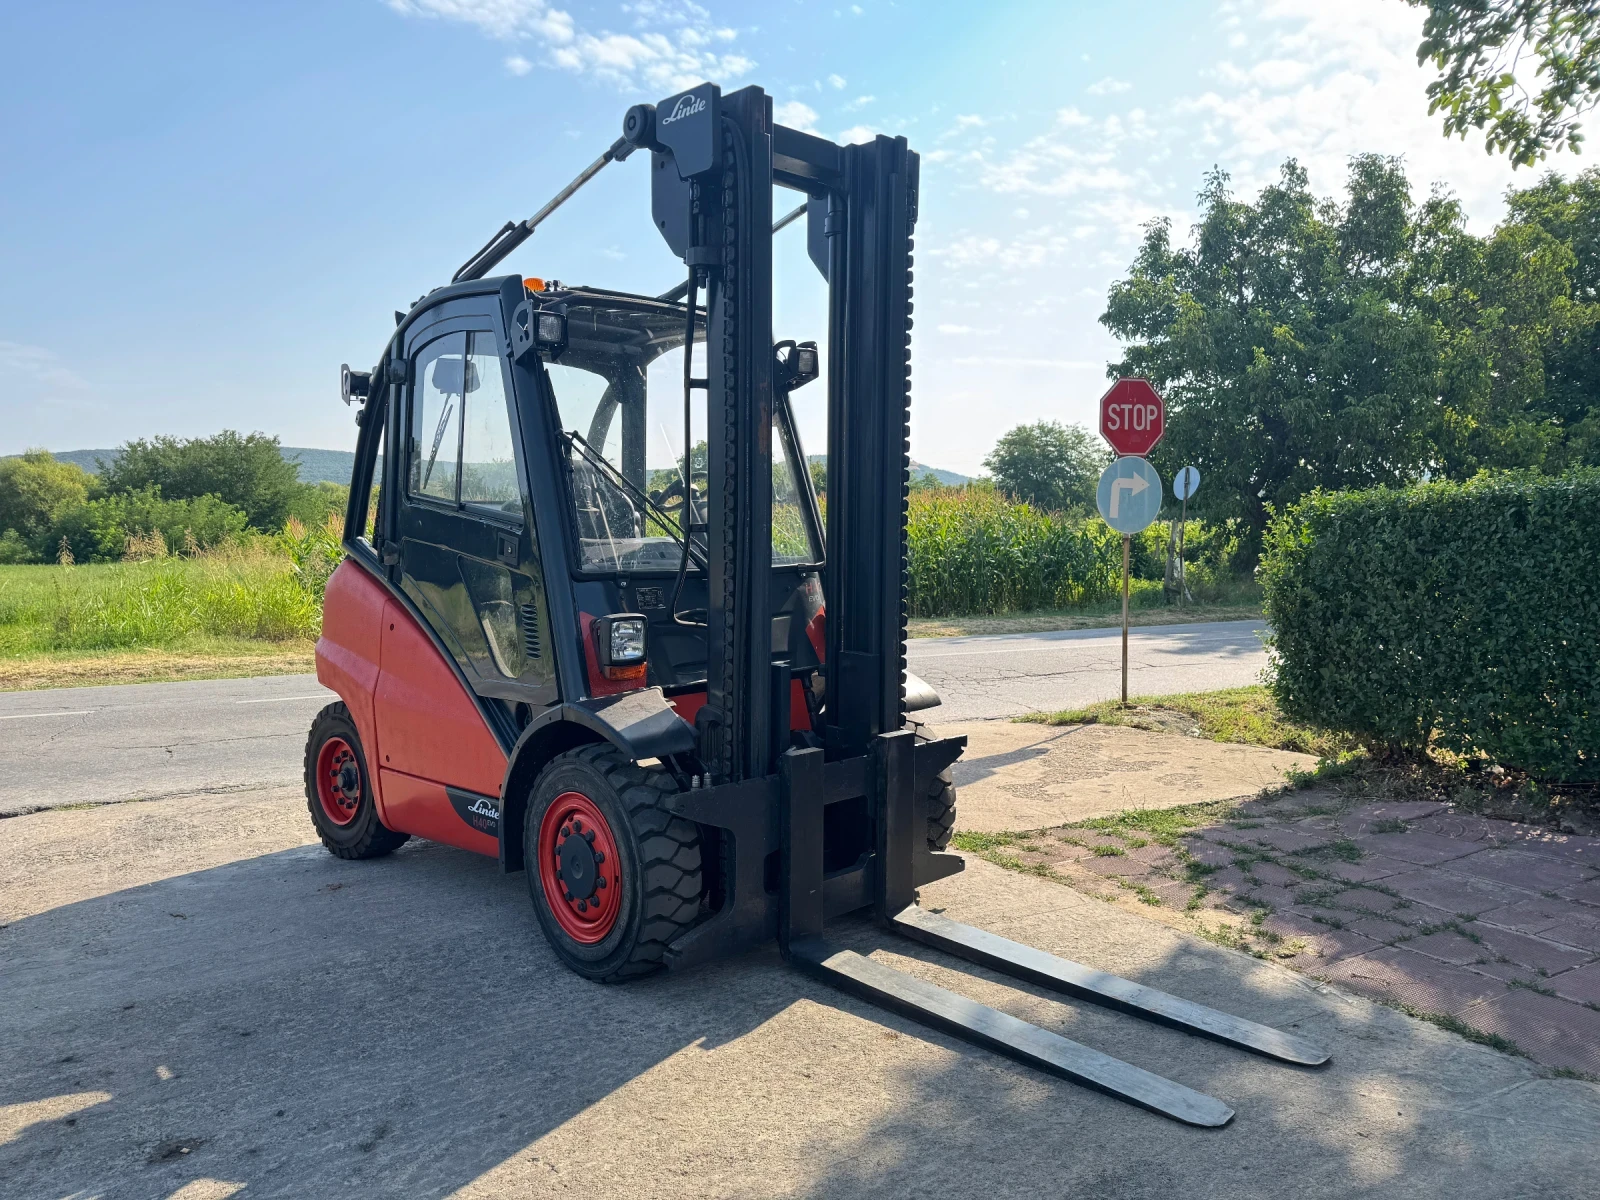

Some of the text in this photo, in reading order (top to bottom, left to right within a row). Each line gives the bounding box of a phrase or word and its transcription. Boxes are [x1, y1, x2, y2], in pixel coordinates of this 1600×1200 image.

[662, 94, 706, 125] Linde
[1107, 403, 1158, 431] STOP
[467, 798, 500, 820] Linde
